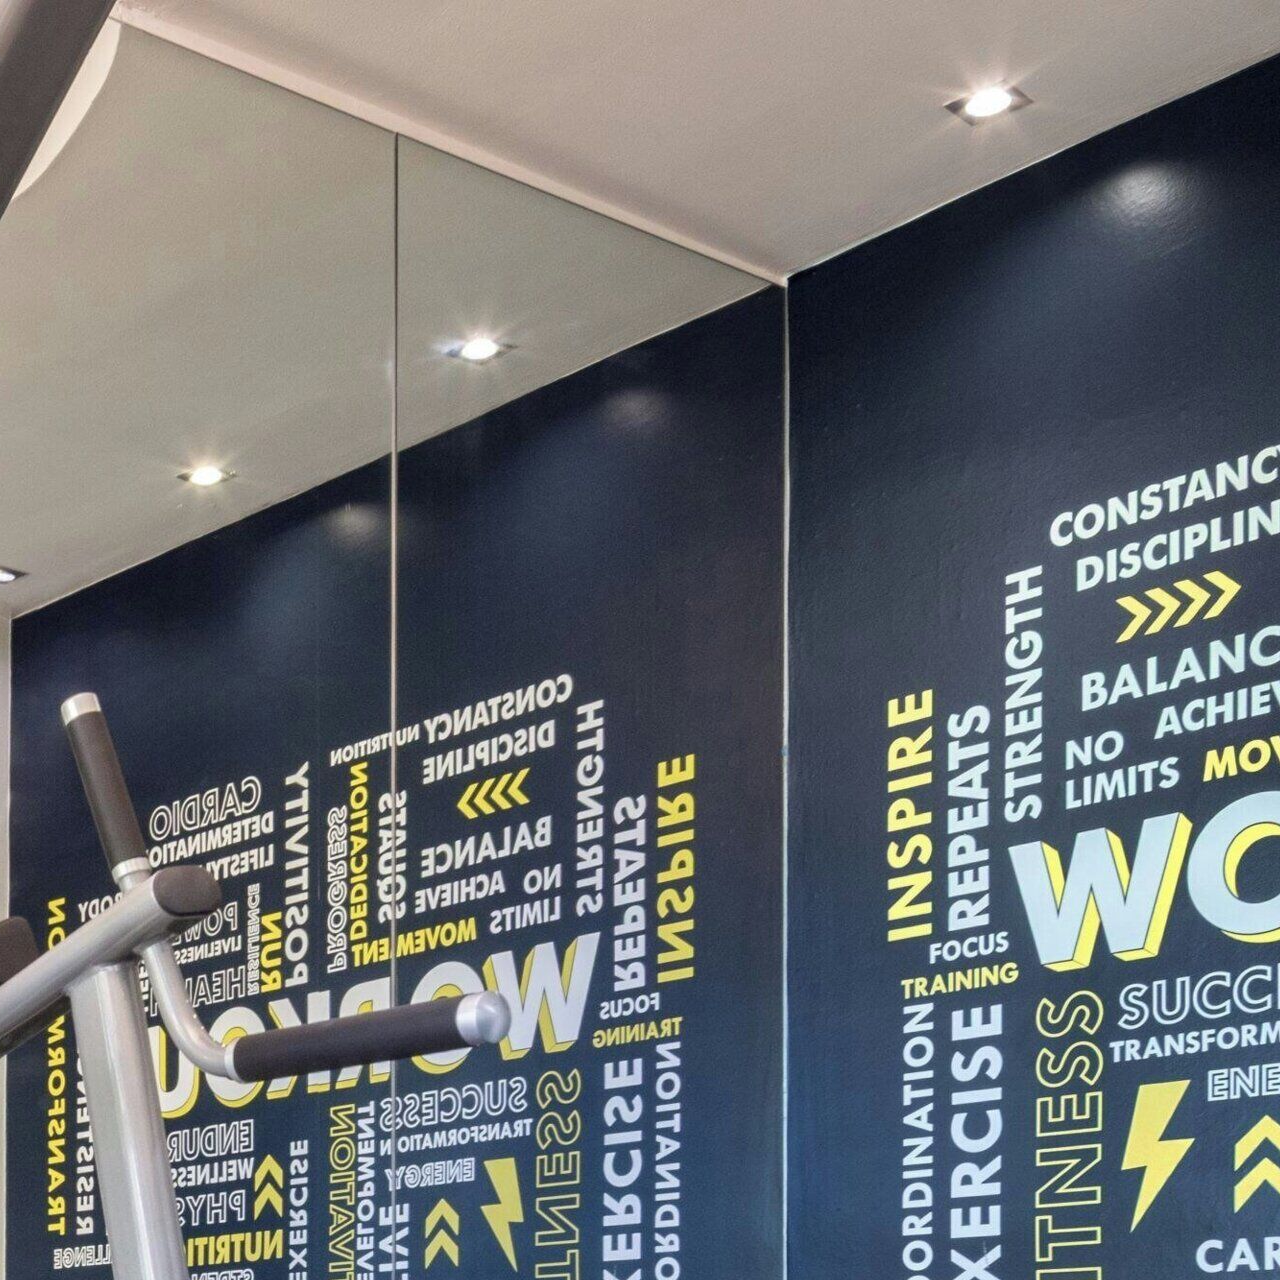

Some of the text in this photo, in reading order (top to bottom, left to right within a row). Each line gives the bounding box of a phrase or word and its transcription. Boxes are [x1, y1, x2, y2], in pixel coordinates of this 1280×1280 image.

[1005, 565, 1042, 822] STRENGTH
[1065, 731, 1124, 769] NO
[1065, 757, 1180, 810] LIMITS
[887, 689, 933, 941] INSPIRE
[947, 705, 991, 930] REPEATS
[929, 932, 1009, 963] FOCUS
[901, 963, 1019, 999] TRAINING
